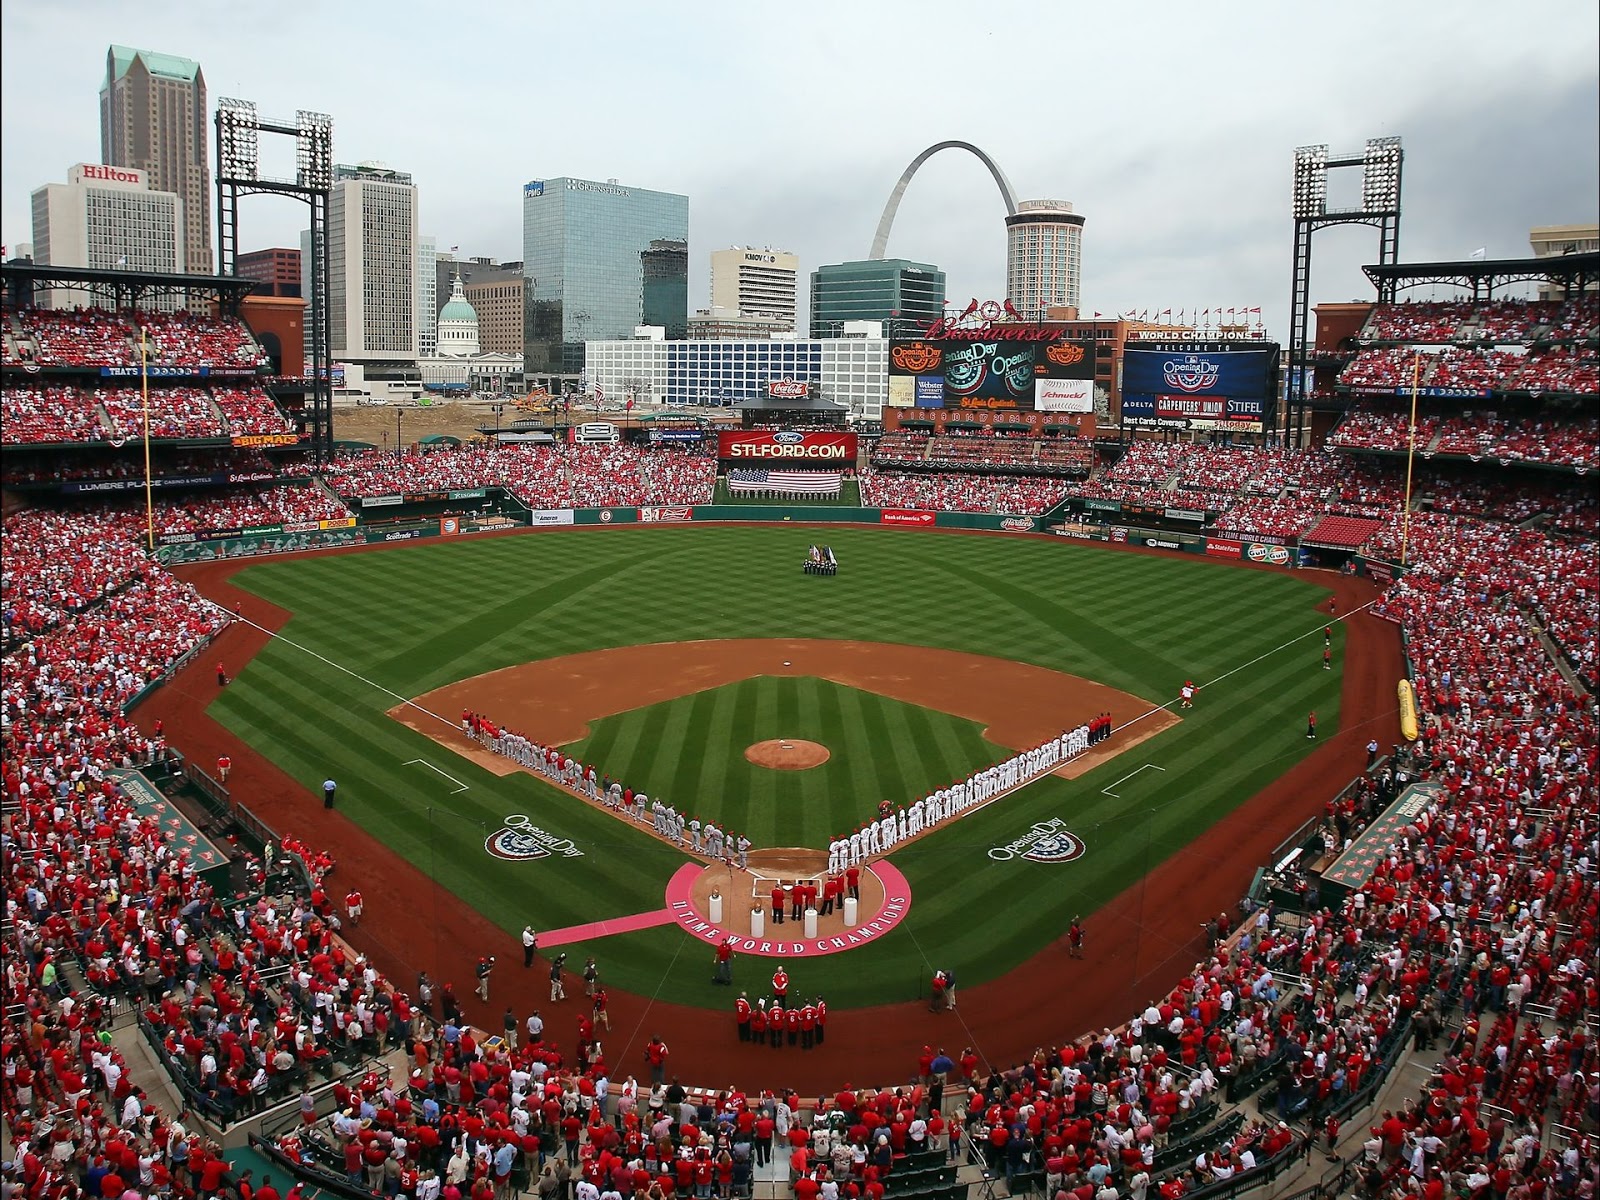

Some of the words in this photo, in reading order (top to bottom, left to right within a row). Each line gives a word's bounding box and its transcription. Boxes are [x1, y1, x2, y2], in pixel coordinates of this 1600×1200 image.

[83, 165, 140, 183] Hilton
[525, 187, 542, 198] KPMG
[745, 253, 762, 262] KMOV
[917, 318, 1064, 341] Budweiser
[1139, 331, 1179, 339] WORLD
[1181, 331, 1253, 340] CHAMPIONS
[892, 347, 926, 358] Opening
[926, 347, 942, 358] Day
[970, 343, 998, 360] Day
[1046, 345, 1072, 355] Opening
[1072, 346, 1085, 354] Day
[992, 352, 1032, 375] Opening
[1163, 361, 1201, 374] Opening
[1200, 362, 1220, 374] Day
[109, 368, 138, 376] THAT'S
[774, 383, 803, 394] Coca-Cola
[918, 381, 943, 389] Webster
[1041, 391, 1087, 399] Schnucks
[1401, 388, 1426, 396] THAT'S
[987, 397, 1017, 408] Cardinals
[1158, 399, 1201, 412] CARPENTERS'
[1203, 401, 1223, 413] UNION
[1227, 399, 1263, 413] STIFEL
[919, 412, 925, 421] 2
[930, 412, 935, 421] 6
[941, 412, 947, 421] 9
[952, 413, 961, 421] 10
[965, 413, 974, 422] 14
[979, 413, 988, 422] 17
[1009, 414, 1021, 423] 24
[1026, 415, 1037, 424] 42
[1042, 415, 1054, 425] 45
[1123, 416, 1138, 424] Best
[1138, 417, 1157, 425] Cards
[1157, 418, 1187, 428] Coverage
[241, 437, 264, 446] BIG
[264, 435, 292, 444] MAC
[779, 434, 798, 442] Ford
[731, 443, 846, 458] STLFORD.COM
[251, 472, 274, 481] Cardinals
[127, 479, 164, 488] PLACE
[603, 512, 609, 520] 6
[385, 531, 412, 541] Scottrade
[1239, 532, 1259, 542] WORLD
[1259, 535, 1286, 545] CHAMPS
[1157, 540, 1180, 549] MIDWEST
[504, 814, 561, 846] Opening
[548, 839, 585, 858] Day
[988, 829, 1048, 861] Opening
[1030, 817, 1067, 834] Day
[679, 910, 720, 940] TIME
[726, 934, 806, 953] WORLD
[816, 896, 905, 952] CHAMPIONS
